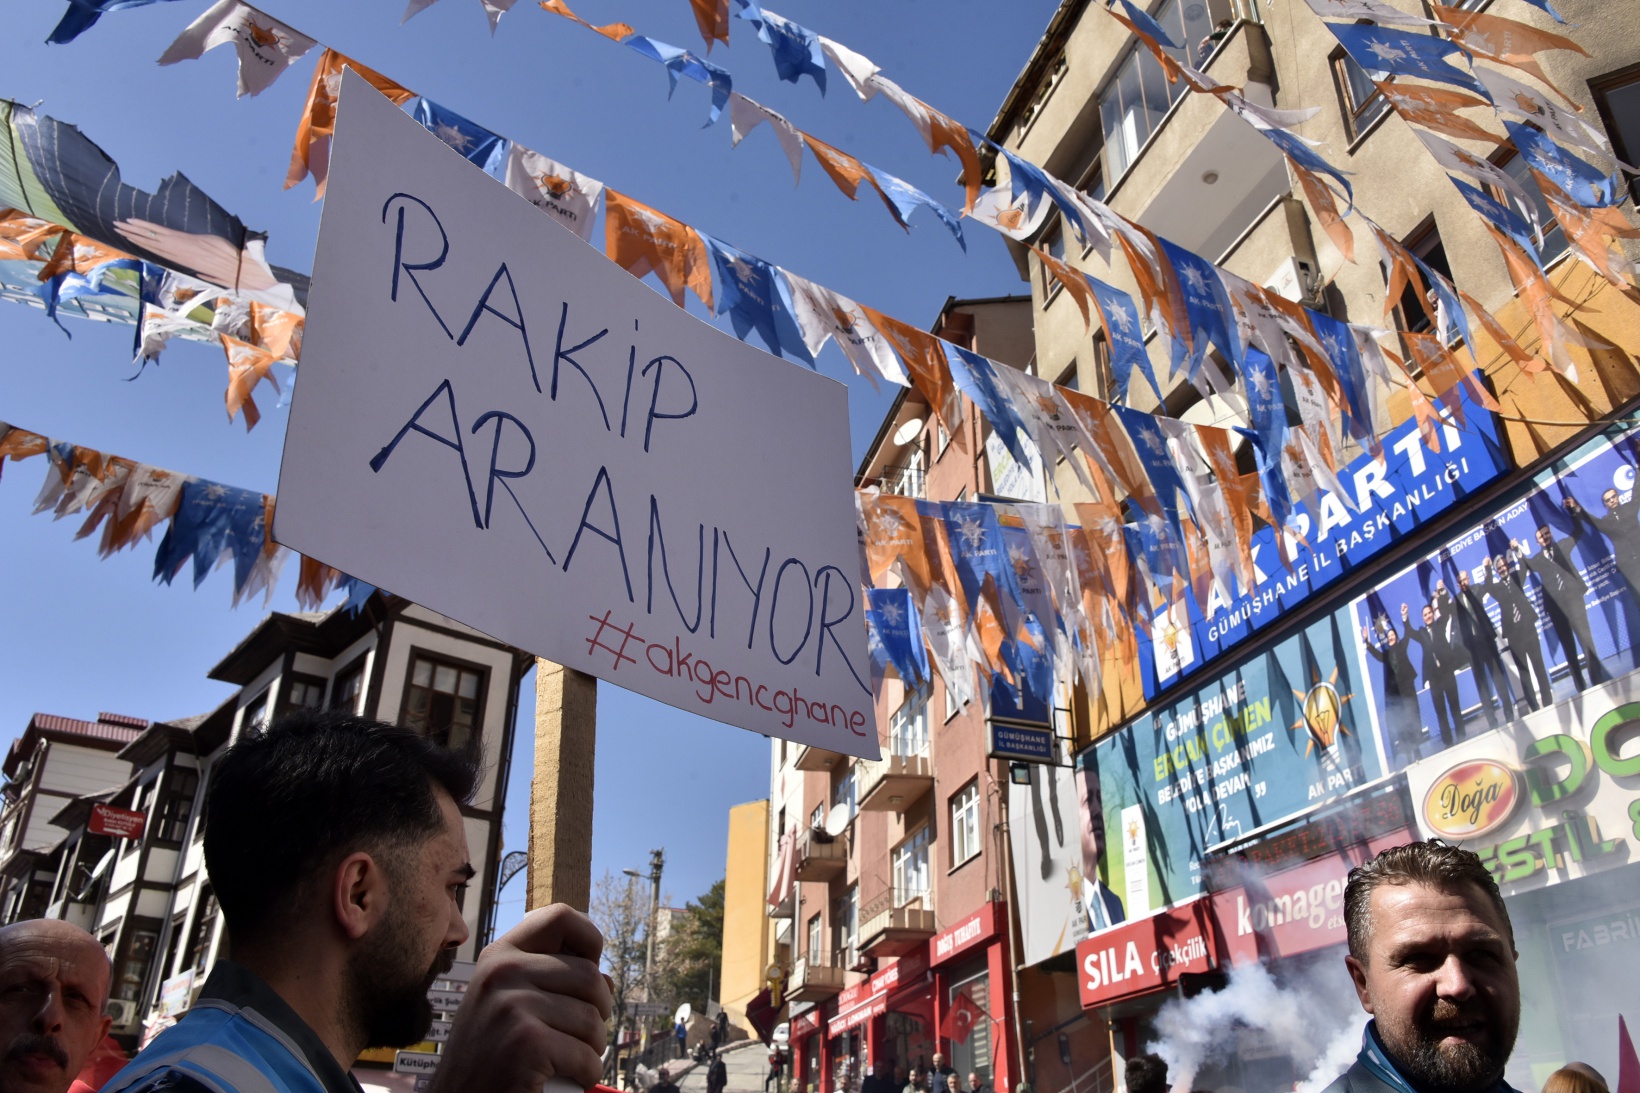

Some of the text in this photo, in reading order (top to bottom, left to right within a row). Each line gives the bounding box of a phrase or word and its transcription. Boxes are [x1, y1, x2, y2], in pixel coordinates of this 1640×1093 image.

[382, 192, 698, 453] RAKİP
[369, 379, 874, 697] ARANIYOR
[1207, 562, 1309, 642] GÜMÜŞHANE
[1336, 456, 1470, 558] BAŞKANLIĞI
[585, 609, 868, 738] #akgencghane
[997, 730, 1046, 744] GÜMÜŞHANE
[1006, 741, 1047, 753] BAŞKANLIĞI
[1153, 696, 1272, 782] ERCAN ÇİMEN
[1157, 732, 1276, 806] BELEDİYE BAŞKANIMIZ
[1213, 770, 1252, 802] DEVAM
[1307, 780, 1327, 801] AK
[1440, 777, 1504, 825] Doğa
[1084, 940, 1145, 991] SILA
